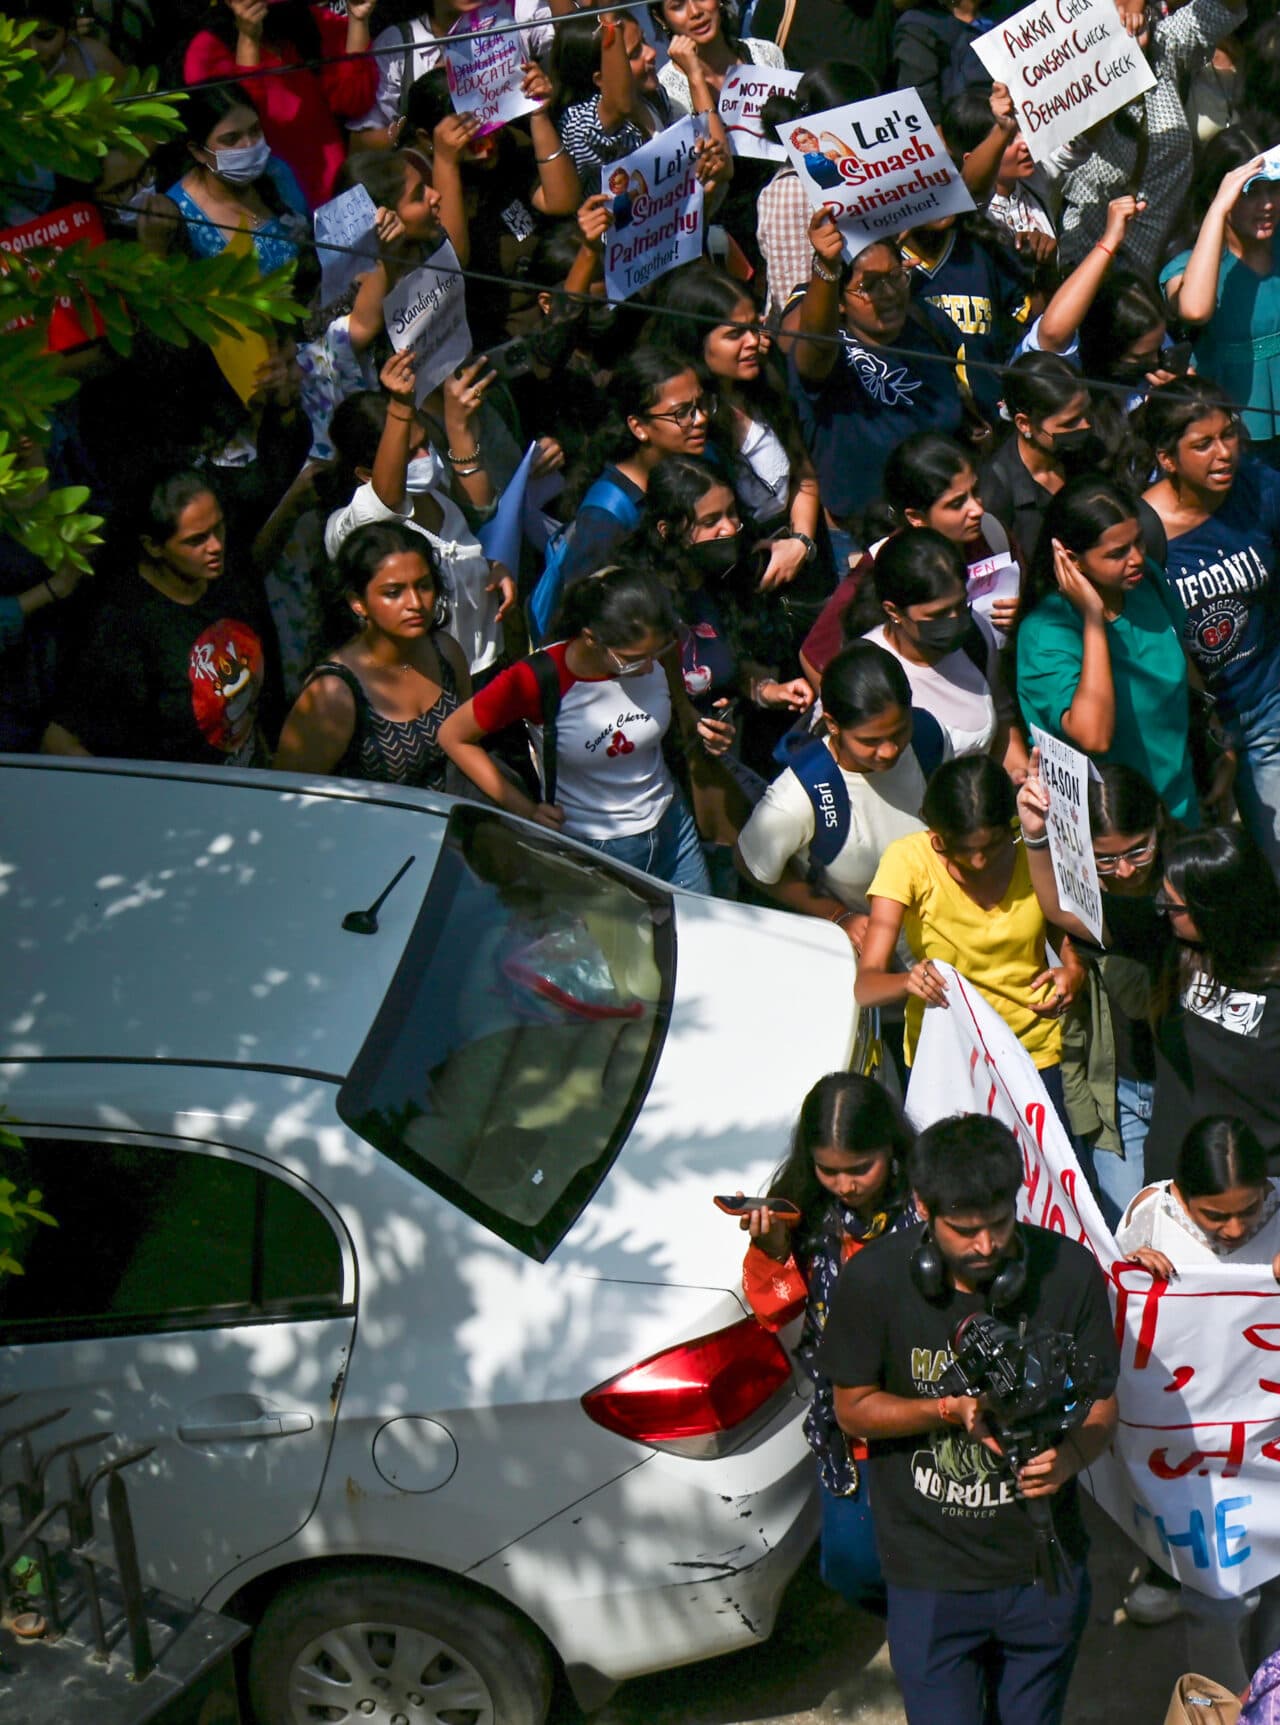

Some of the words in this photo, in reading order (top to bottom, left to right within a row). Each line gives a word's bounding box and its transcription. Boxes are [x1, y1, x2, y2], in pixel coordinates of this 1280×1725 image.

[1003, 10, 1056, 59] AUKKAT
[1056, 0, 1093, 24] CHECK
[456, 58, 516, 96] EDUCATE
[1022, 38, 1076, 87] CONSENT
[1072, 23, 1111, 54] CHECK
[474, 101, 499, 122] SON
[480, 80, 513, 104] YOUR
[722, 99, 739, 113] BUT
[740, 83, 769, 97] NOT
[1021, 73, 1098, 132] BEHAVIOUR
[1094, 54, 1137, 87] CHECK
[852, 110, 922, 150] Let's
[654, 140, 698, 186] Let's
[839, 136, 935, 187] Smash
[632, 170, 696, 227] Smash
[822, 168, 952, 224] Patriarchy
[857, 192, 940, 231] Together!
[609, 210, 699, 273] Patriarchy
[624, 240, 680, 289] Together!
[392, 288, 440, 335] Standing
[1166, 546, 1269, 610] IFORNIA
[616, 711, 652, 728] Cherry
[813, 782, 838, 829] safari
[914, 1466, 943, 1498] NO
[946, 1480, 1016, 1509] RULE
[941, 1507, 998, 1519] FOREVER
